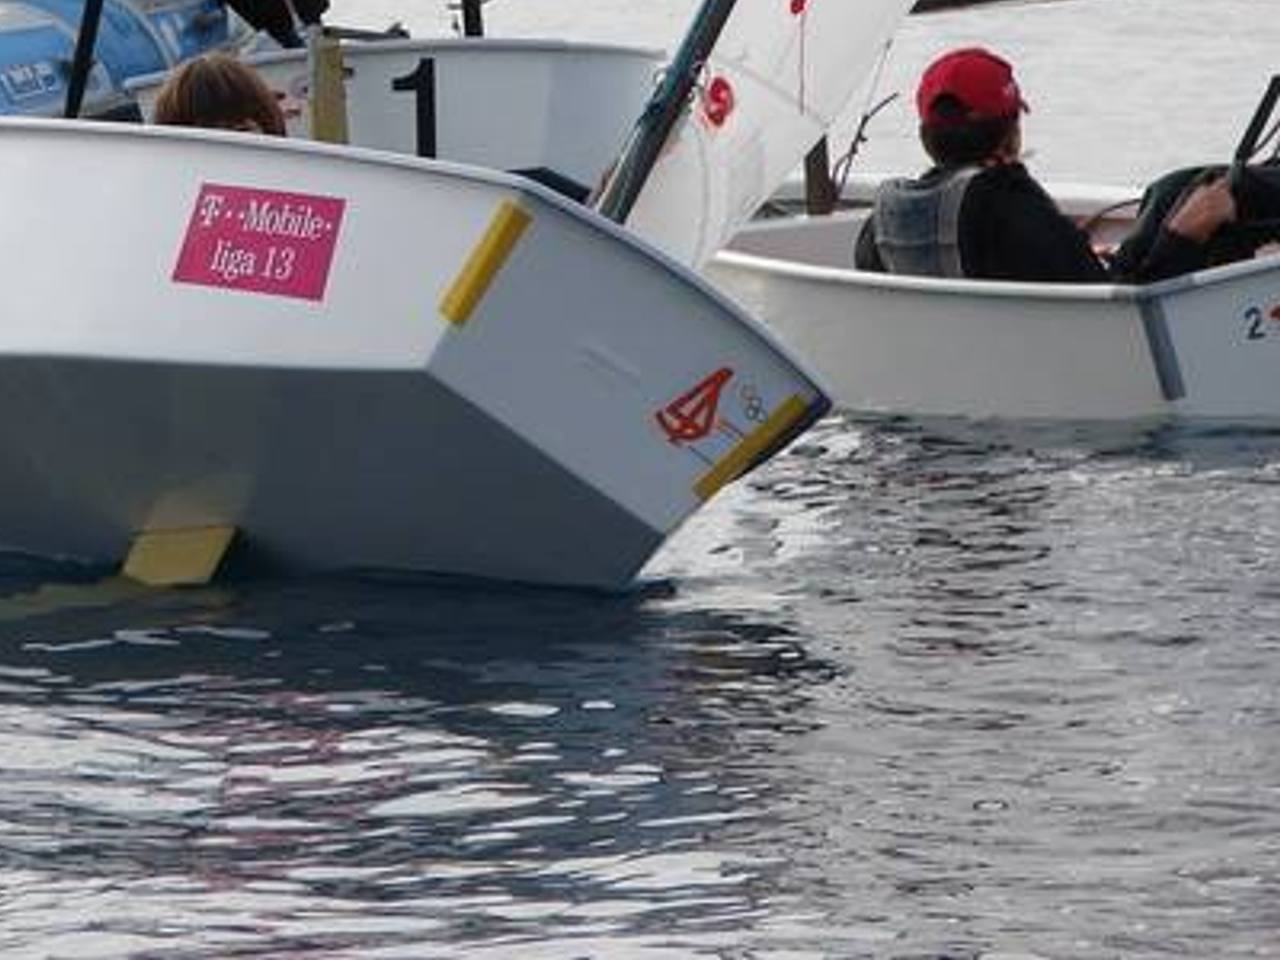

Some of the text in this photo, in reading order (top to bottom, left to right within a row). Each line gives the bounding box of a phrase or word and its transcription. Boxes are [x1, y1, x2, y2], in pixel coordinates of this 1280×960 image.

[392, 58, 437, 158] 1
[211, 239, 295, 280] liga 13
